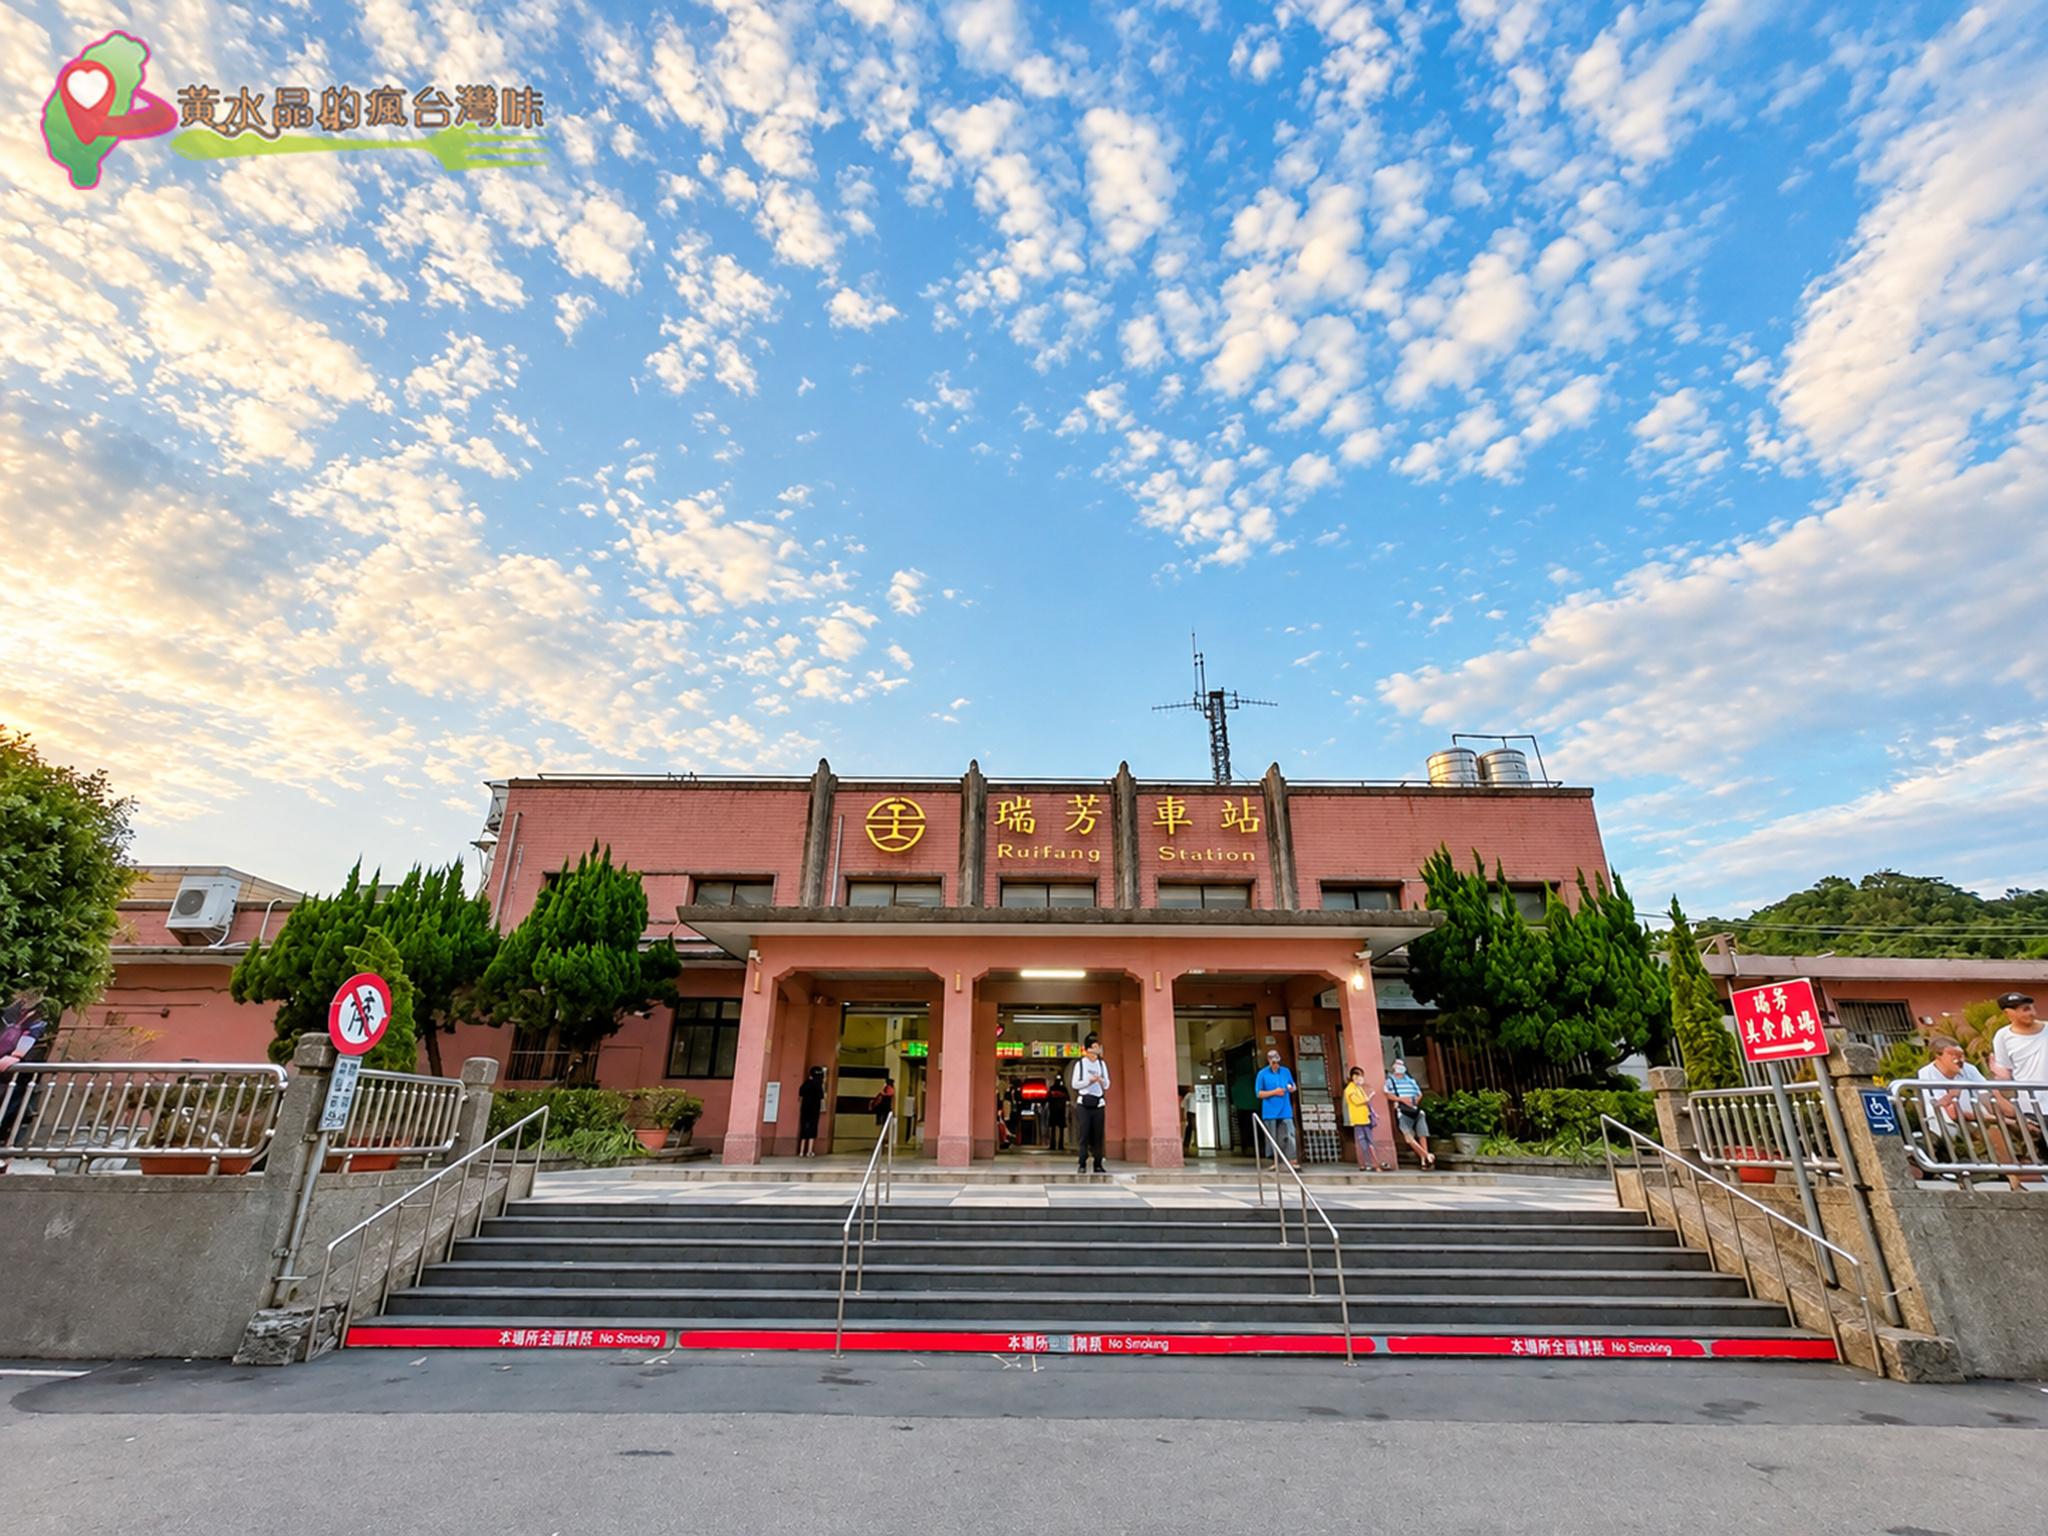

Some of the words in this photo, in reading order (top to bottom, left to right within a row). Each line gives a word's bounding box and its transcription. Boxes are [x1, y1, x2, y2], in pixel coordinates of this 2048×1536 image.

[994, 795, 1103, 835] 瑞芳
[1152, 796, 1260, 835] 車站
[997, 843, 1101, 863] Ruifang
[1158, 845, 1256, 862] Station
[599, 1333, 613, 1344] No
[616, 1333, 660, 1347] Smoking
[1108, 1338, 1123, 1349] No
[1125, 1337, 1169, 1351] Smoking
[1611, 1341, 1625, 1352] No
[1628, 1341, 1672, 1356] Smoking
